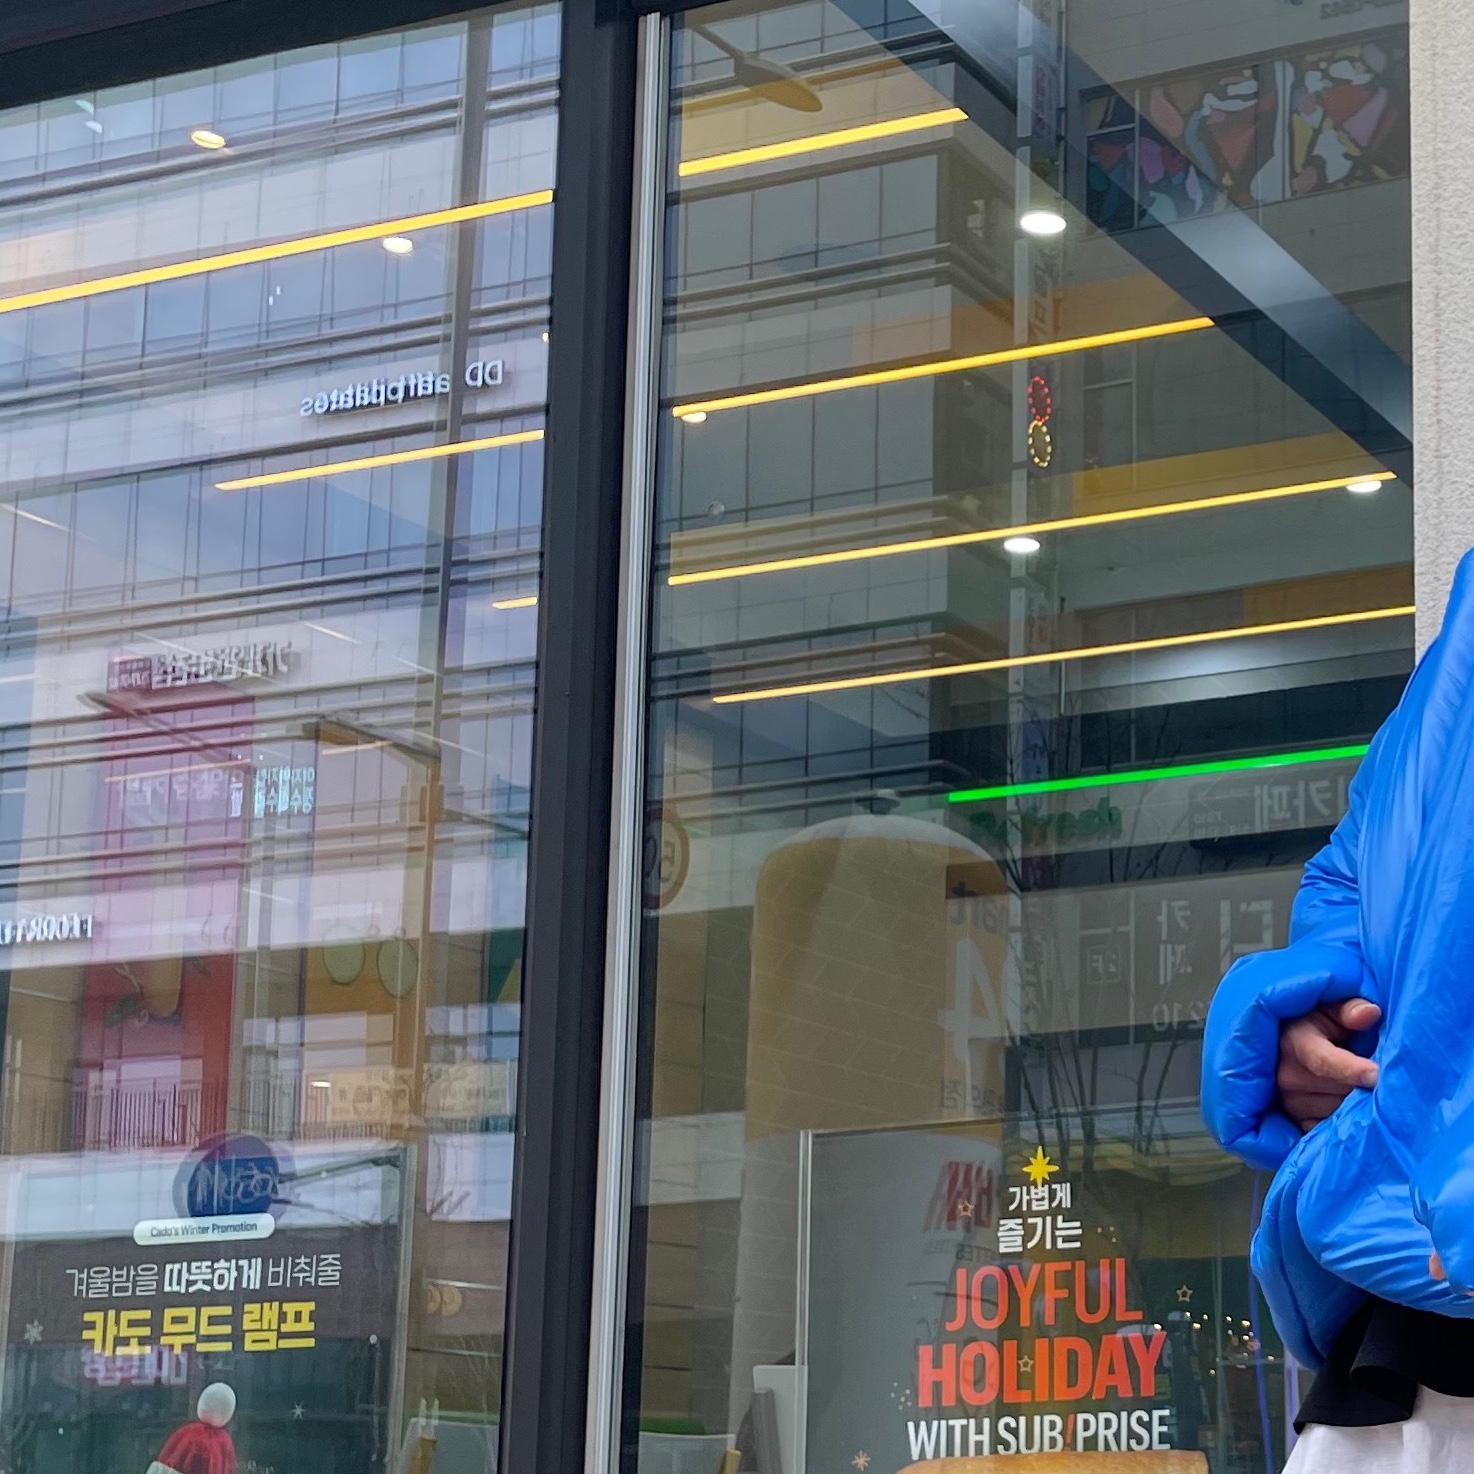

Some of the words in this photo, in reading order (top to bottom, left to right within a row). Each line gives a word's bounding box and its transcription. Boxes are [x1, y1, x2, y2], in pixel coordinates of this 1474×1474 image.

[1007, 1182, 1072, 1211] 가볍게
[180, 1224, 210, 1236] Winter
[211, 1221, 258, 1234] Promotion
[996, 1215, 1083, 1254] 즐기는
[65, 1263, 159, 1299] 겨울밤을
[162, 1257, 264, 1294] 따뜻하게
[267, 1253, 343, 1288] 비춰줄
[945, 1257, 1144, 1332] JOYFUL
[82, 1309, 152, 1357] 카도
[160, 1305, 233, 1355] 무드
[242, 1301, 316, 1351] 램프
[917, 1330, 1168, 1408] HOLIDAY
[907, 1417, 991, 1461] WITH
